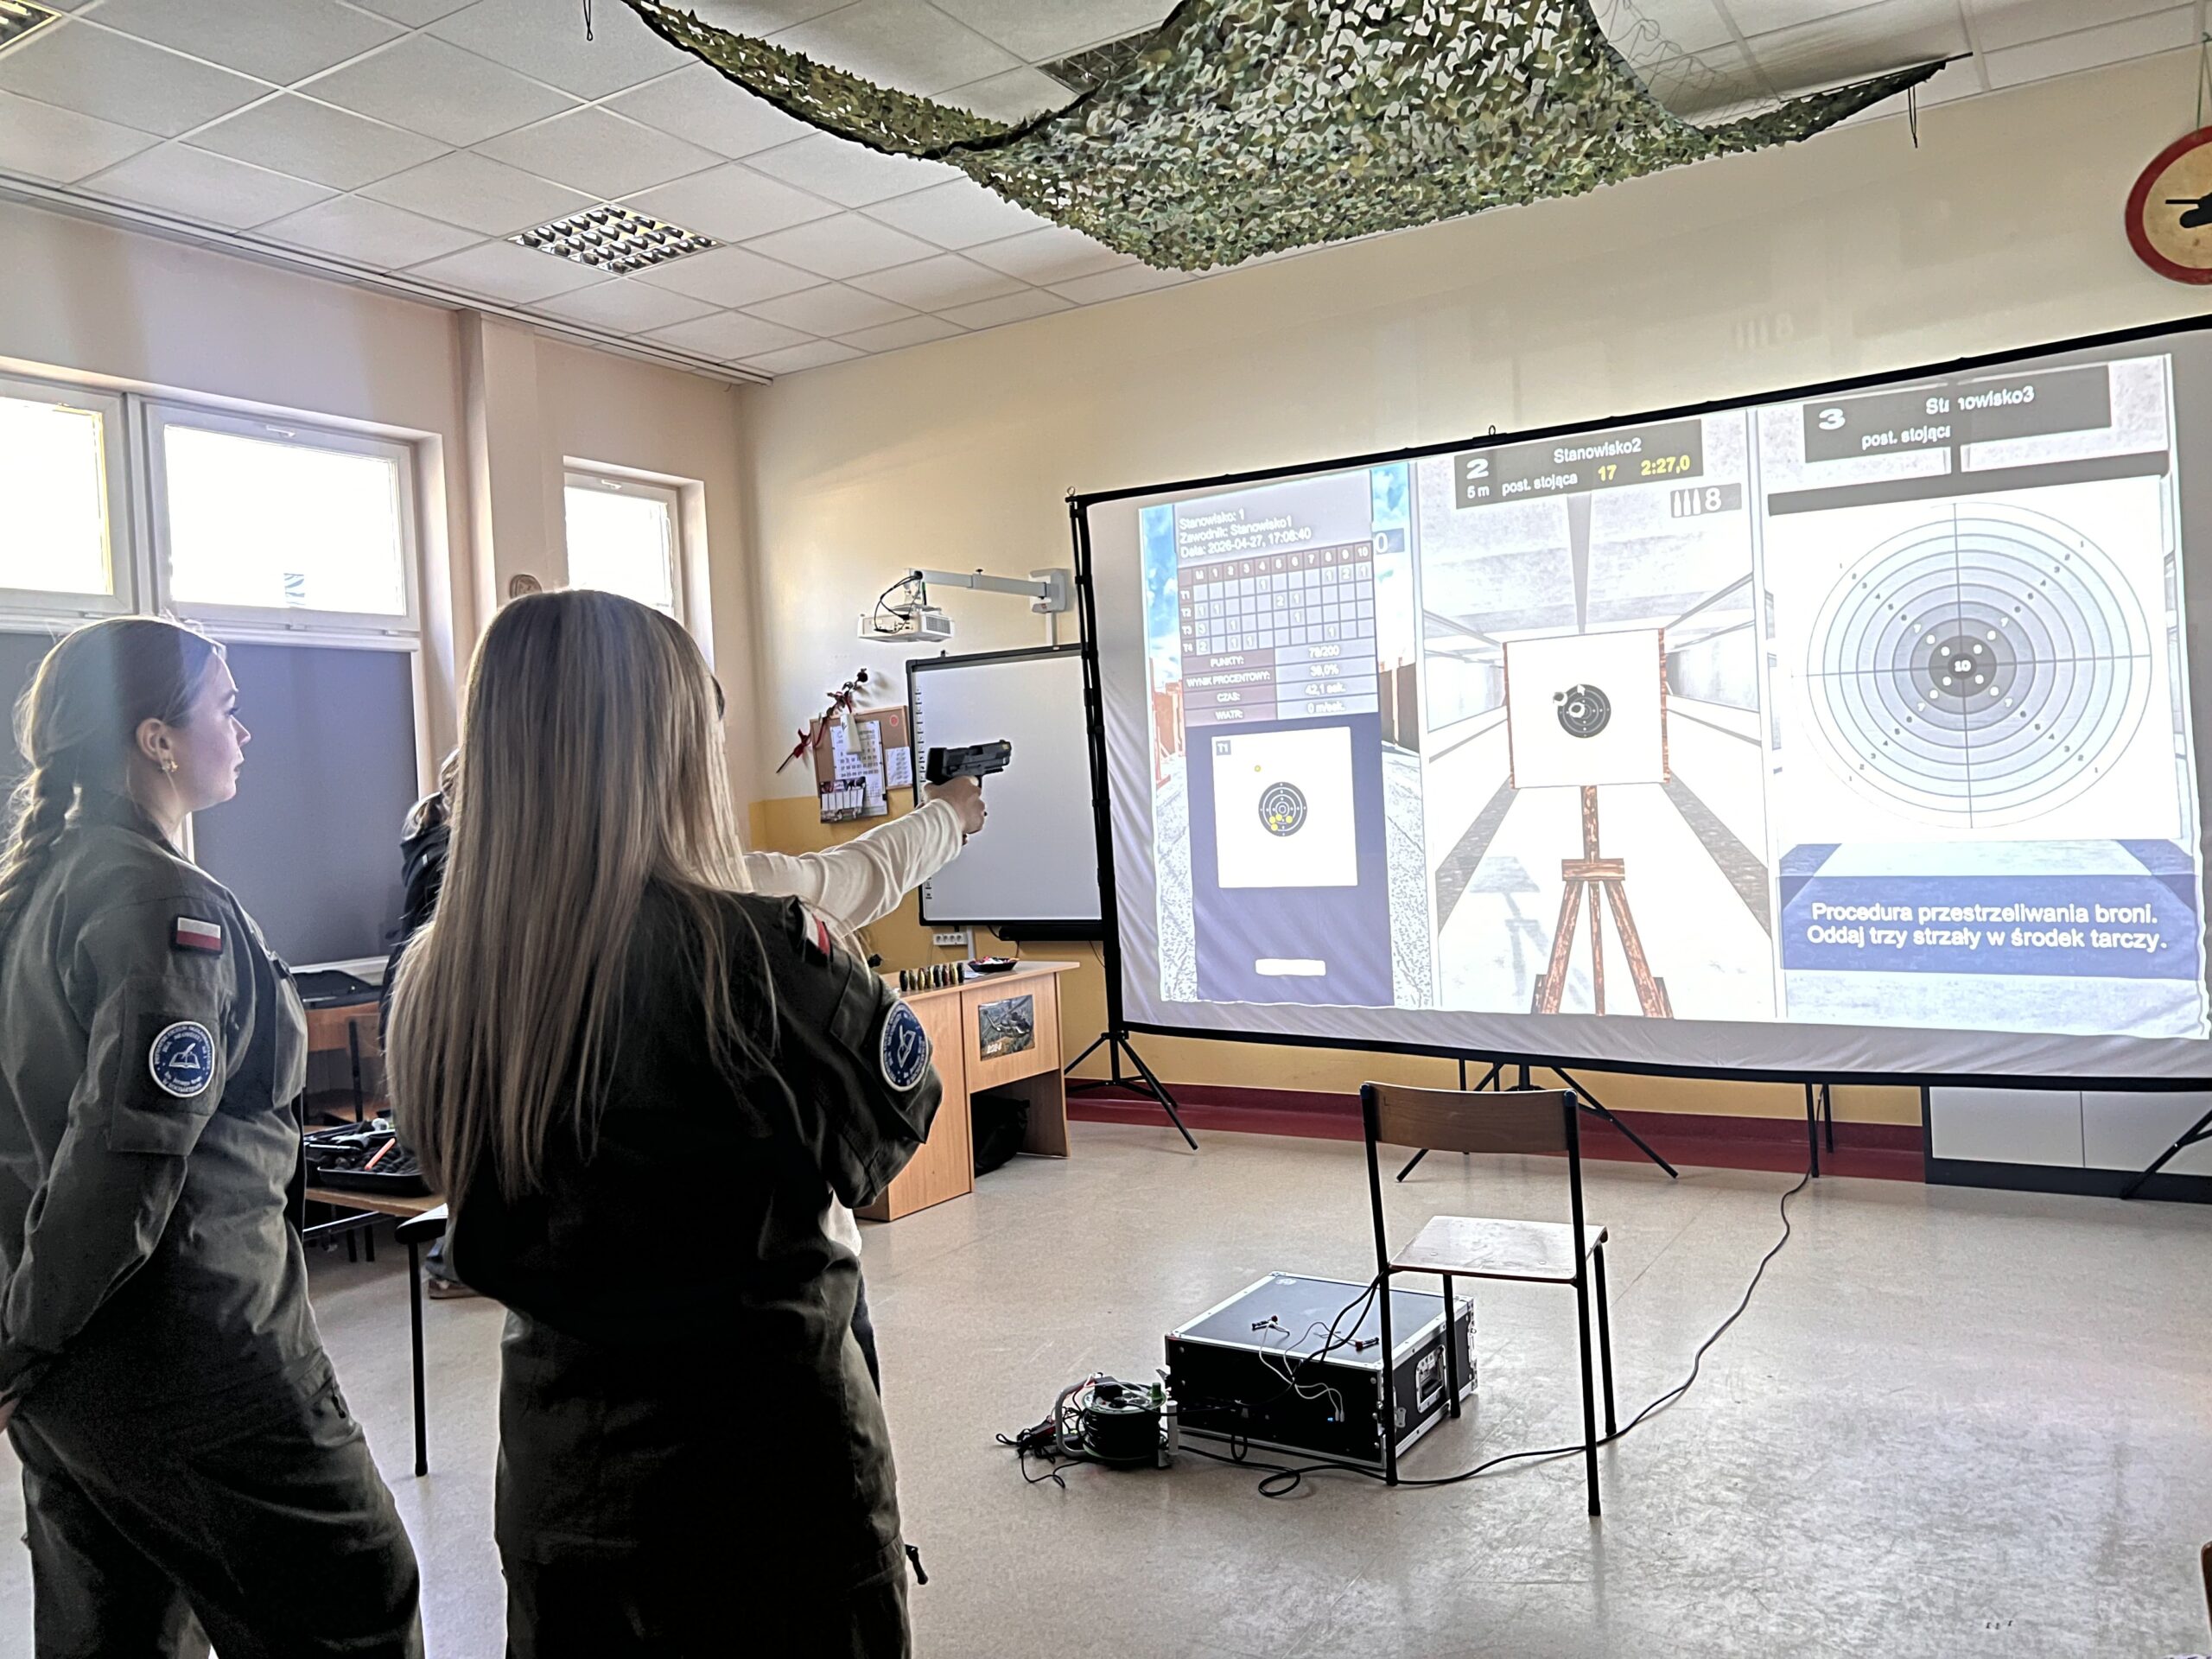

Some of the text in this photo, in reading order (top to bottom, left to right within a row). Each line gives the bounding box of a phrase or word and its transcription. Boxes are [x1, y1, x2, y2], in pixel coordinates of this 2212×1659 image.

[1819, 408, 1846, 430] 3
[1862, 430, 1898, 451] post.
[1466, 437, 1642, 480] 2 Stanowisko2
[1502, 480, 1531, 497] post.
[1533, 473, 1578, 491] stojąca
[1597, 465, 1617, 481] 17
[1641, 455, 1690, 476] 2:27,0
[1705, 487, 1721, 512] 8
[1239, 508, 1244, 520] 1
[1955, 659, 1971, 672] 10
[1812, 902, 2158, 926] Procedura przestrzeliwania broni.
[1807, 925, 2168, 953] Oddaj trzy strzały w środek tarczy.
